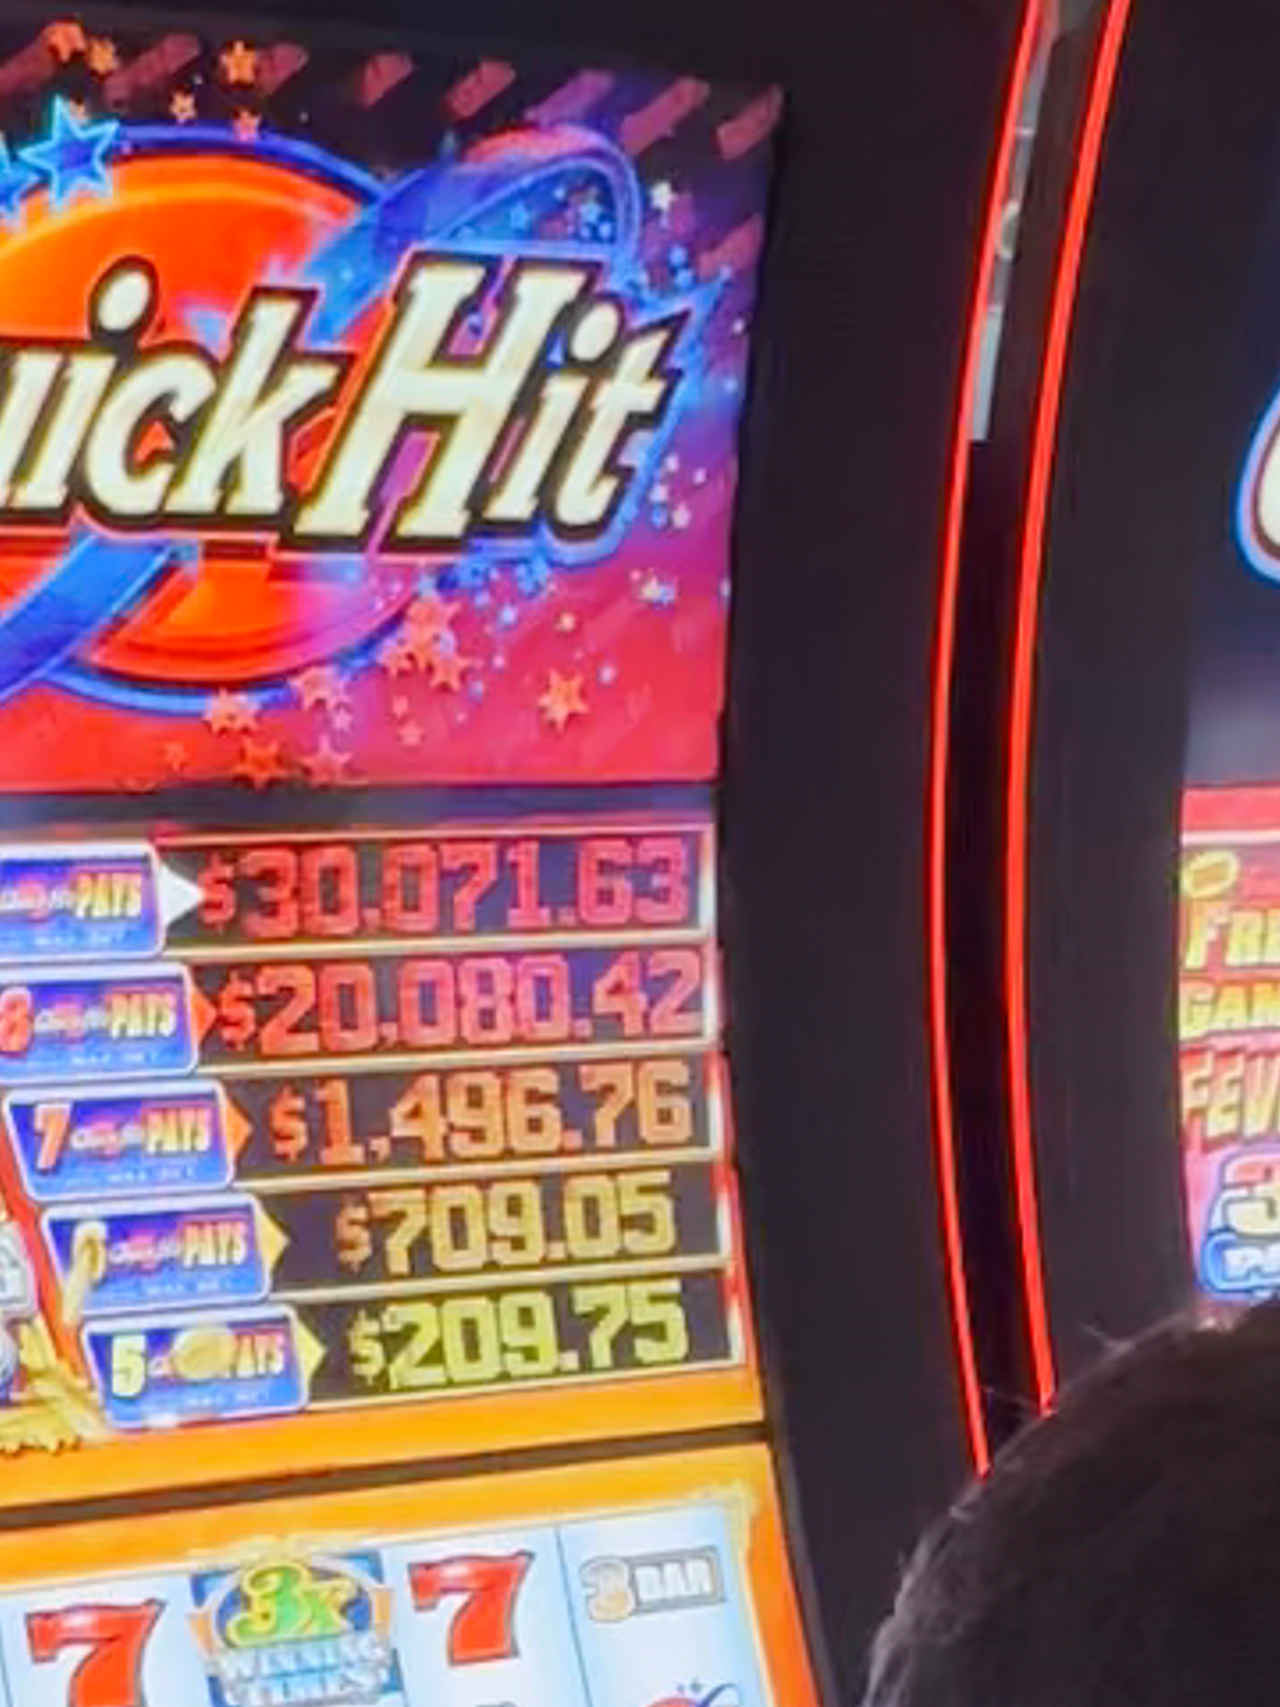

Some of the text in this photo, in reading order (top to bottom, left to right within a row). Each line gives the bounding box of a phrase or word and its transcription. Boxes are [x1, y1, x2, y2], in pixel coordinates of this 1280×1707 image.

[294, 260, 680, 540] Hit
[219, 949, 703, 1057] $20,080.42
[34, 1103, 72, 1173] 7
[269, 1058, 693, 1166] $1,496.76
[336, 1170, 675, 1278] $709.05
[111, 1333, 147, 1399] 5
[348, 1278, 689, 1390] $209.75
[407, 1550, 536, 1668] 7
[635, 1559, 715, 1605] BAR
